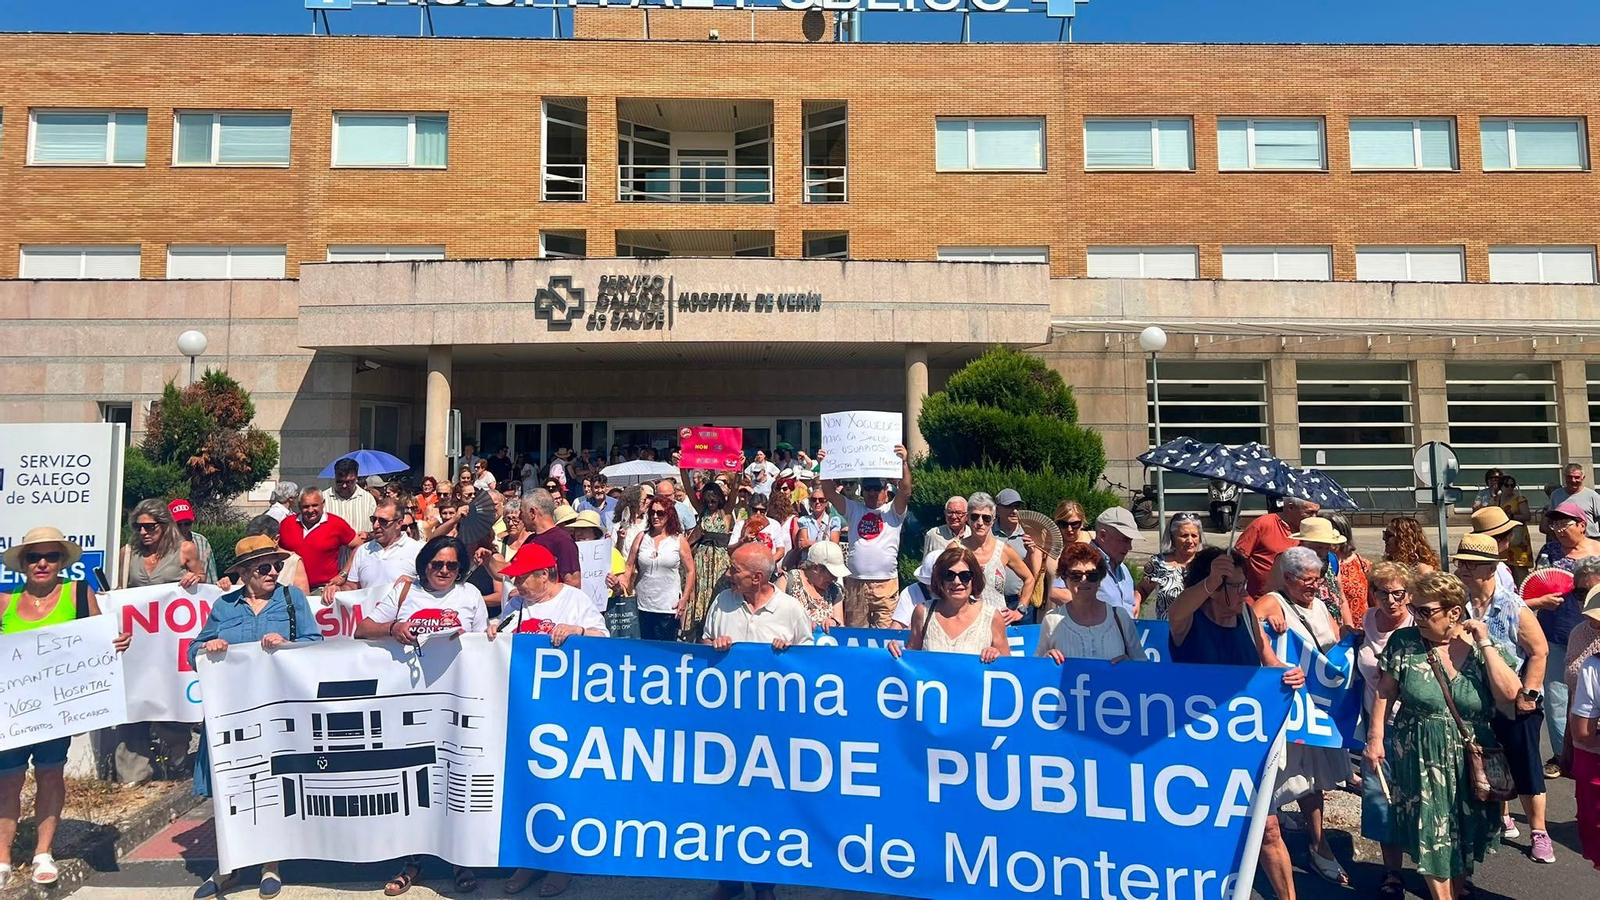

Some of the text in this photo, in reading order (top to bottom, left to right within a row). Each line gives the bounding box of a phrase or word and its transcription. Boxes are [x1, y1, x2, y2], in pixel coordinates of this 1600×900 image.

[678, 292, 750, 310] HOSPITAL
[755, 293, 775, 310] DE
[20, 454, 91, 468] SERVIZO
[16, 472, 91, 486] GALEGO
[6, 487, 90, 504] de SAÚDE
[37, 633, 83, 656] ESTA
[531, 647, 1268, 743] Plataforma en Defensa
[527, 723, 1257, 828] SANIDADE PÚBLICA
[525, 803, 812, 868] Comarca
[838, 823, 916, 879] de
